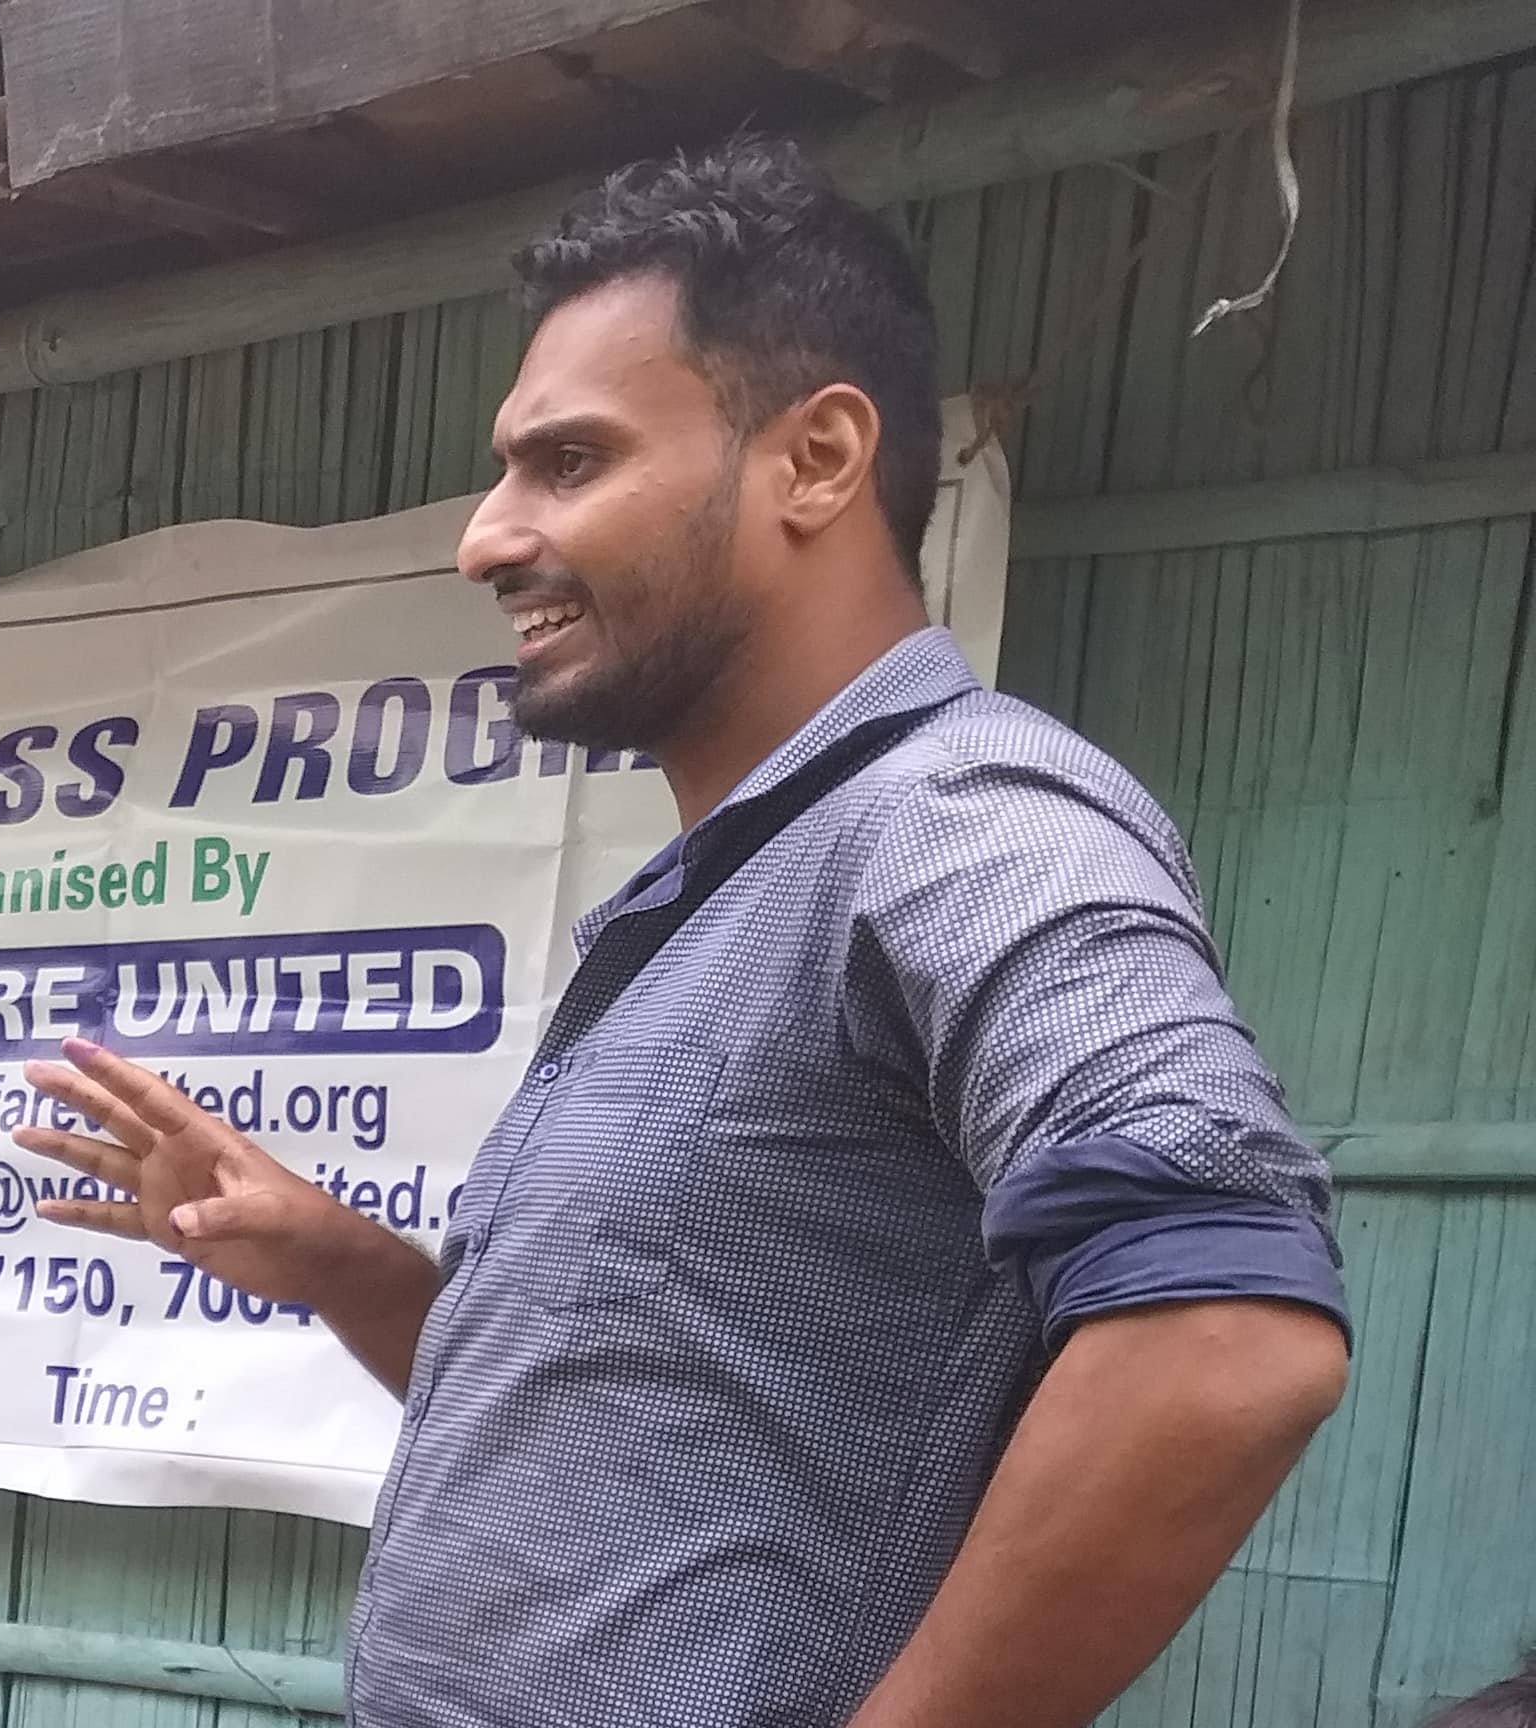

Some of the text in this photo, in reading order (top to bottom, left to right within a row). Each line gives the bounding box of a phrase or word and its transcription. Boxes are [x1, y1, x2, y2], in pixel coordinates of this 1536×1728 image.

[169, 665, 662, 808] PROG
[192, 836, 271, 917] By
[112, 949, 484, 1038] UNITED
